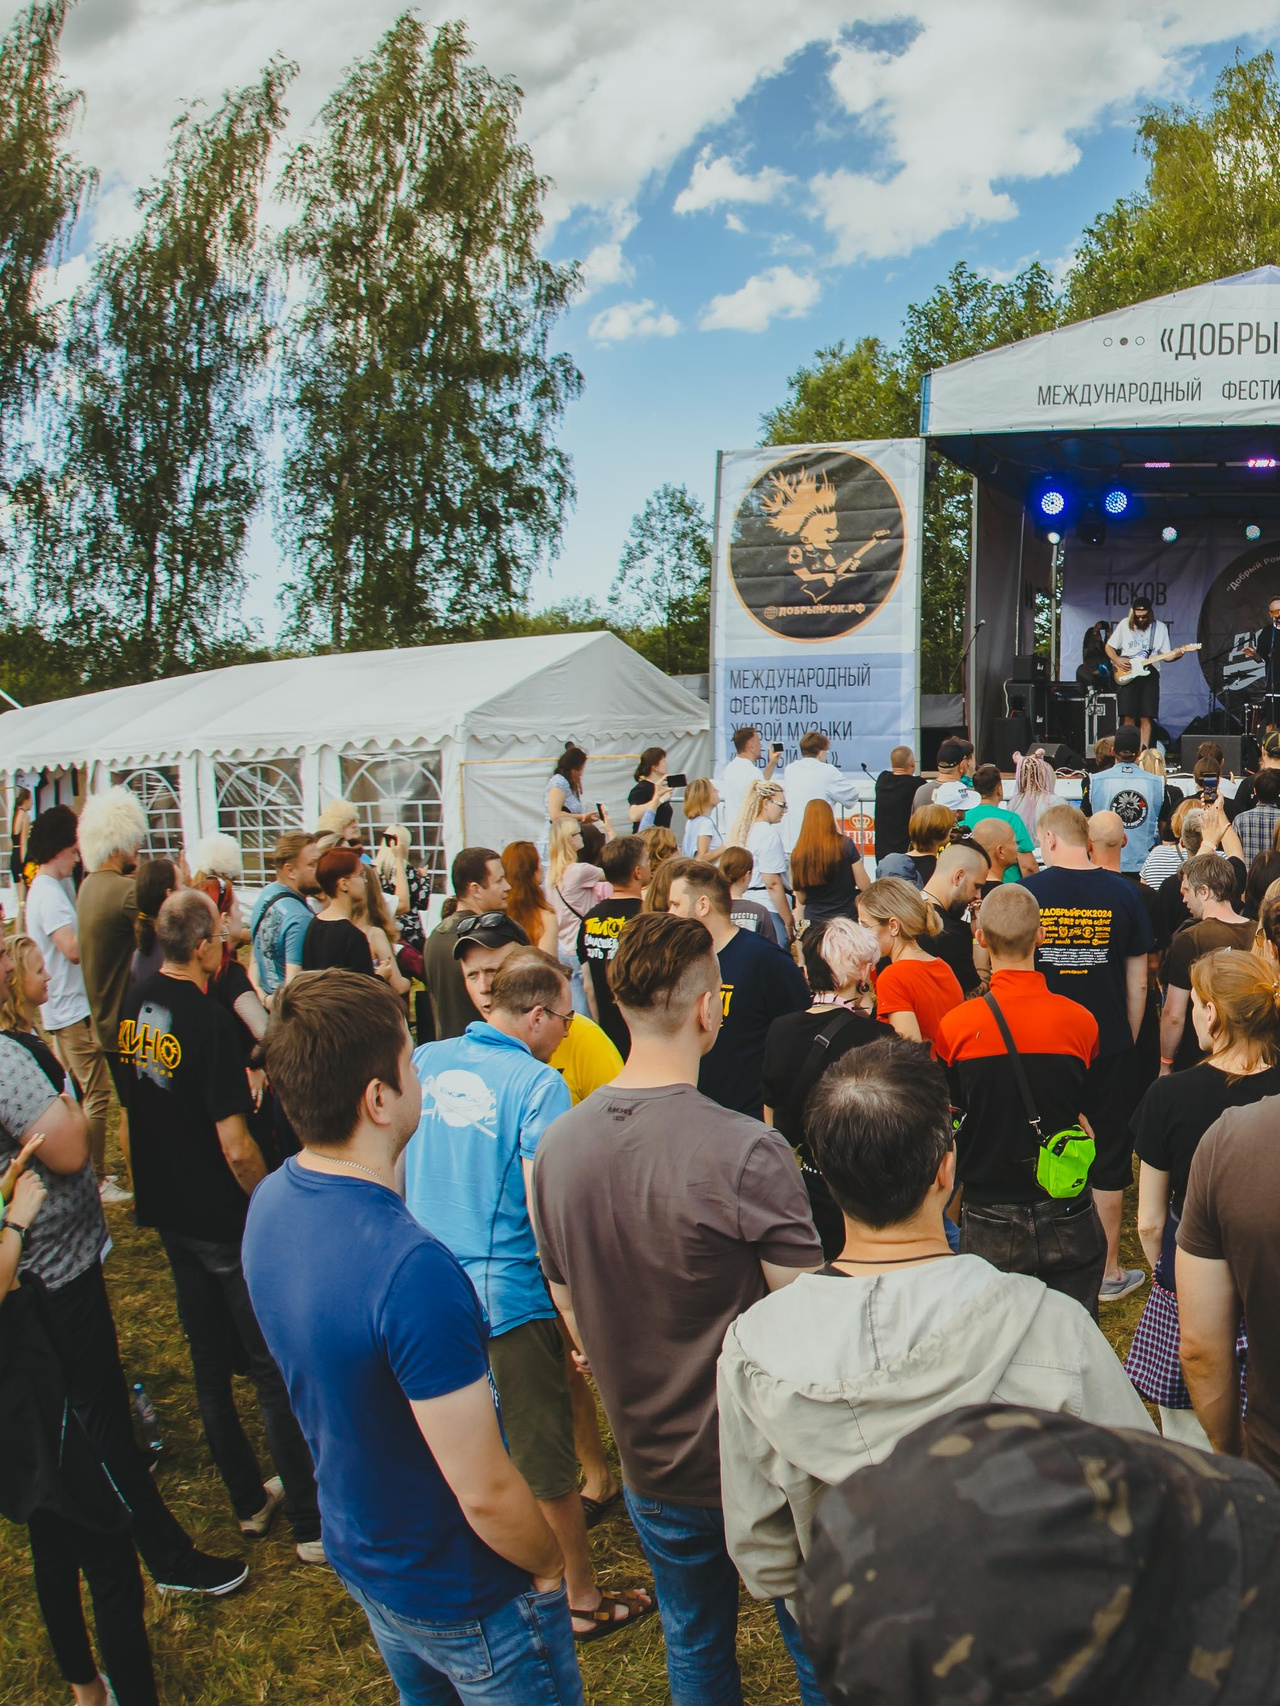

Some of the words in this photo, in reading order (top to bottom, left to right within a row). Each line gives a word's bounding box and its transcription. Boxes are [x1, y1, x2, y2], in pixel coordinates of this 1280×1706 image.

[1037, 377, 1202, 407] МЕЖДУНАРОДНЫЙ
[778, 602, 866, 617] ДОБРЫЙРОК.РФ
[729, 662, 871, 691] МЕЖДУНАРОДНЫЙ
[729, 694, 819, 716] ФЕСТИВАЛЬ
